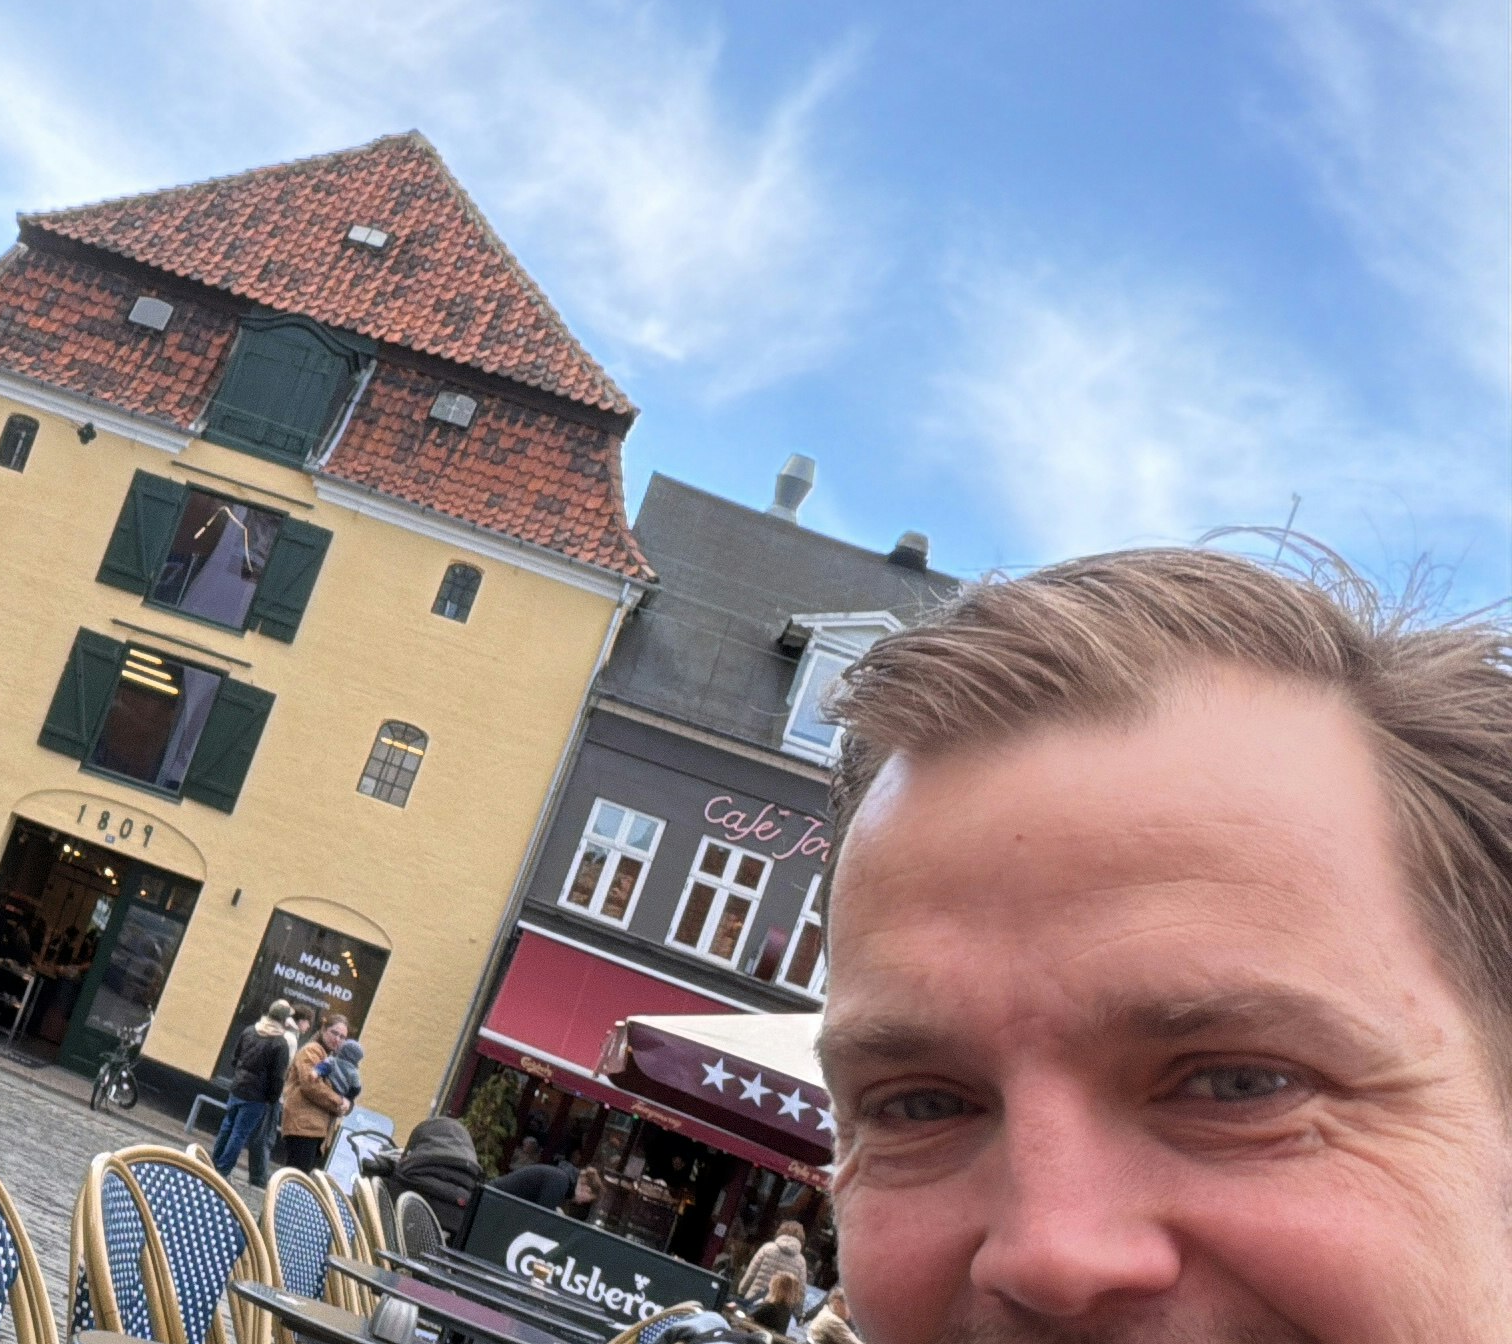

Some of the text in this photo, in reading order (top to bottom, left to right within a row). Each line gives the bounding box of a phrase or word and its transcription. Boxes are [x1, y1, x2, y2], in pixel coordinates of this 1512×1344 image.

[77, 803, 154, 848] 1809
[273, 962, 353, 1002] NØRGAARD
[299, 951, 341, 977] MADS
